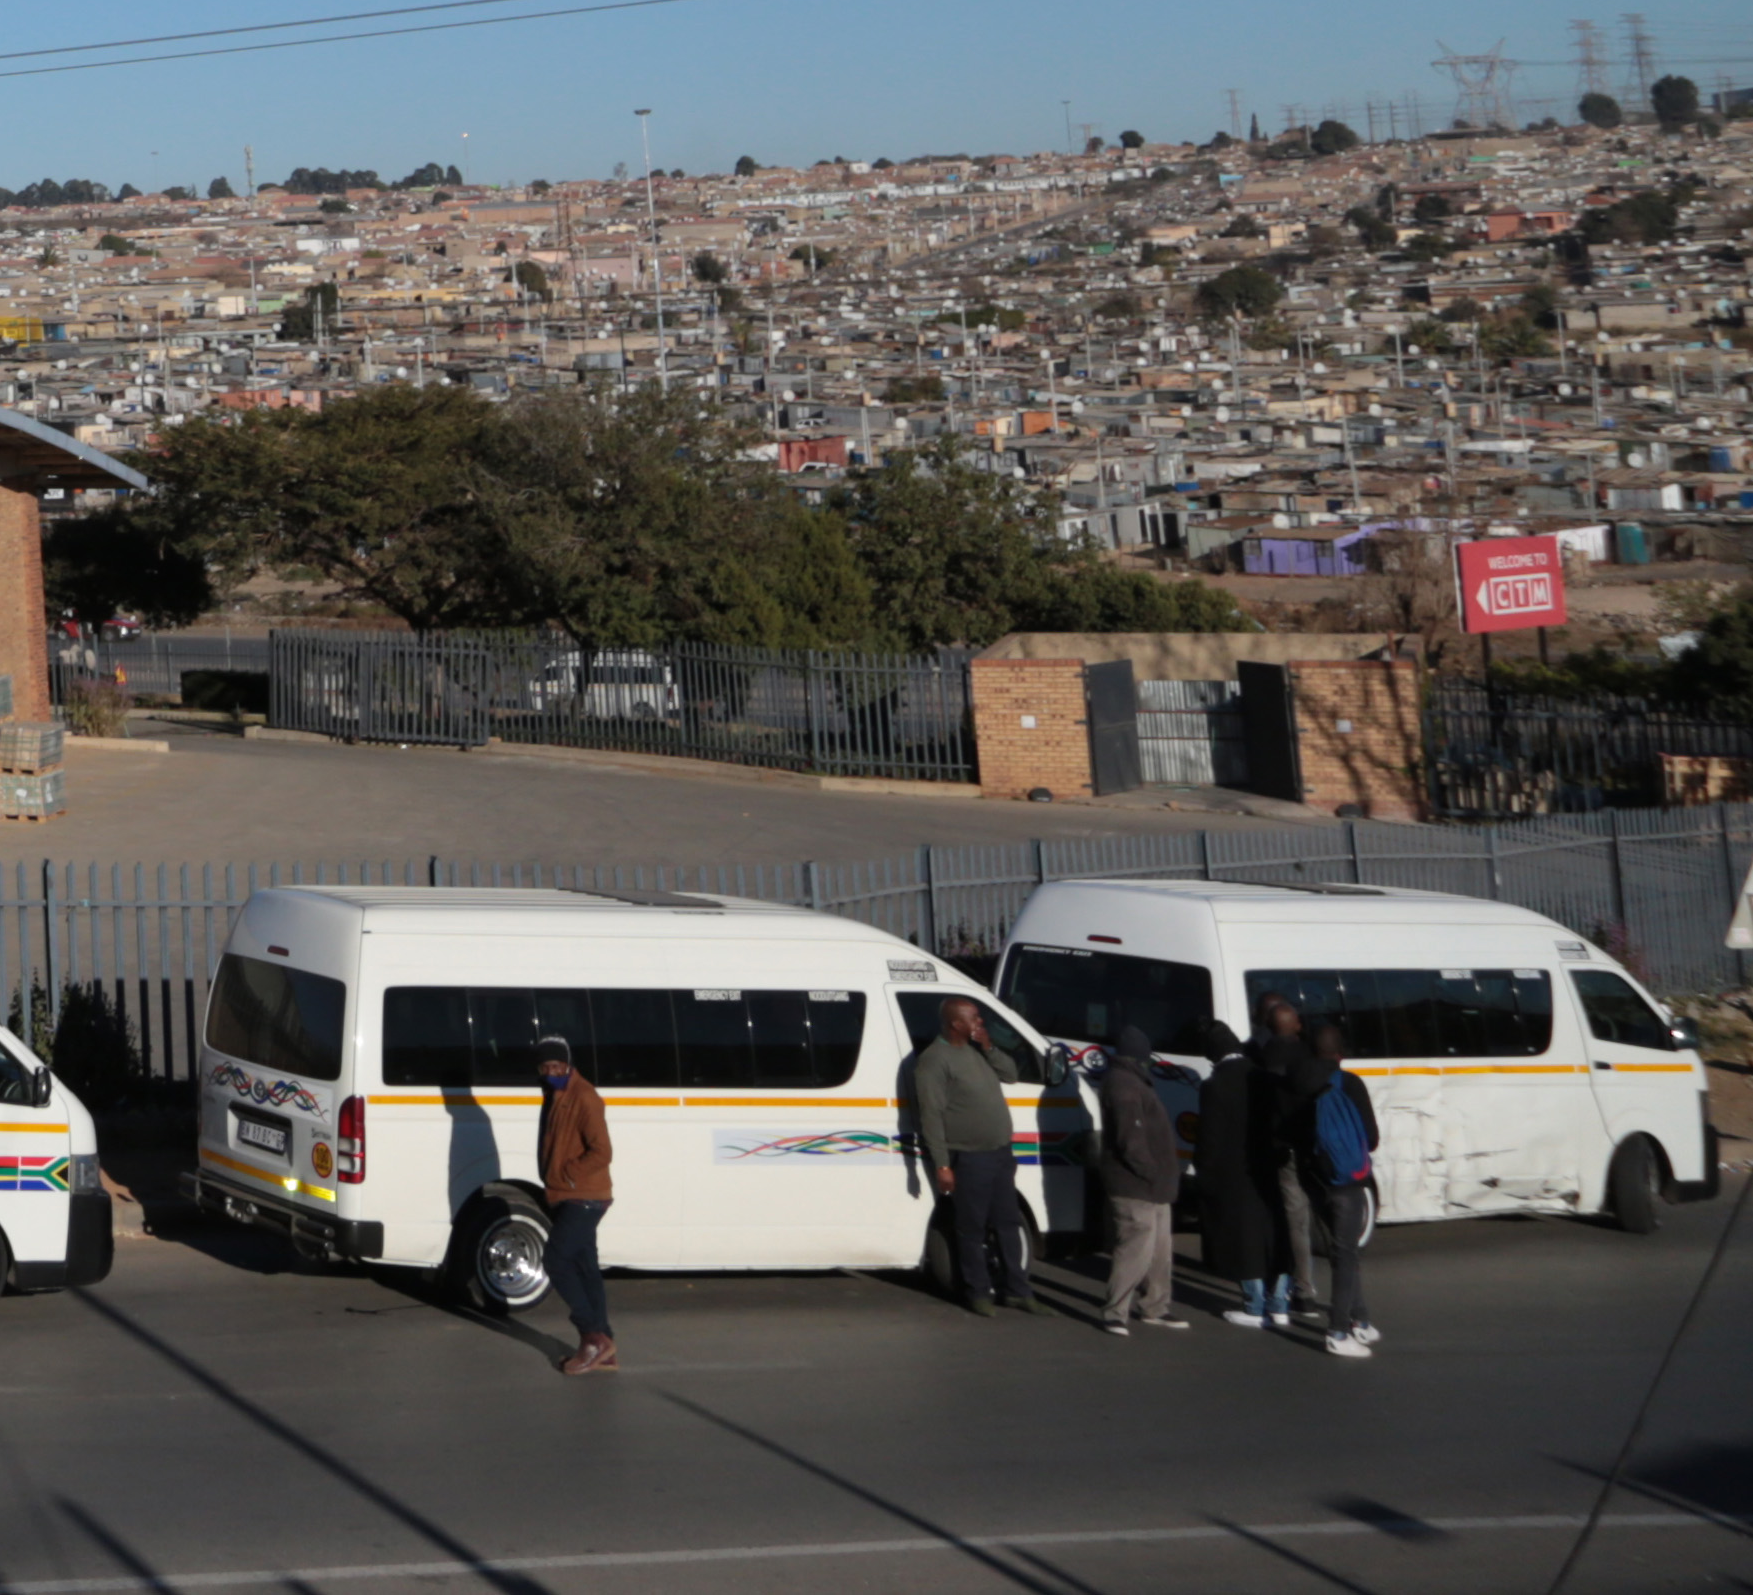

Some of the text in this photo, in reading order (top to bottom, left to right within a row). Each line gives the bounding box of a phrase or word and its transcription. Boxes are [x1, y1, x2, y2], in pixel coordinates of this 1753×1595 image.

[1488, 552, 1547, 569] WELCOME TO
[1497, 581, 1547, 607] CTM
